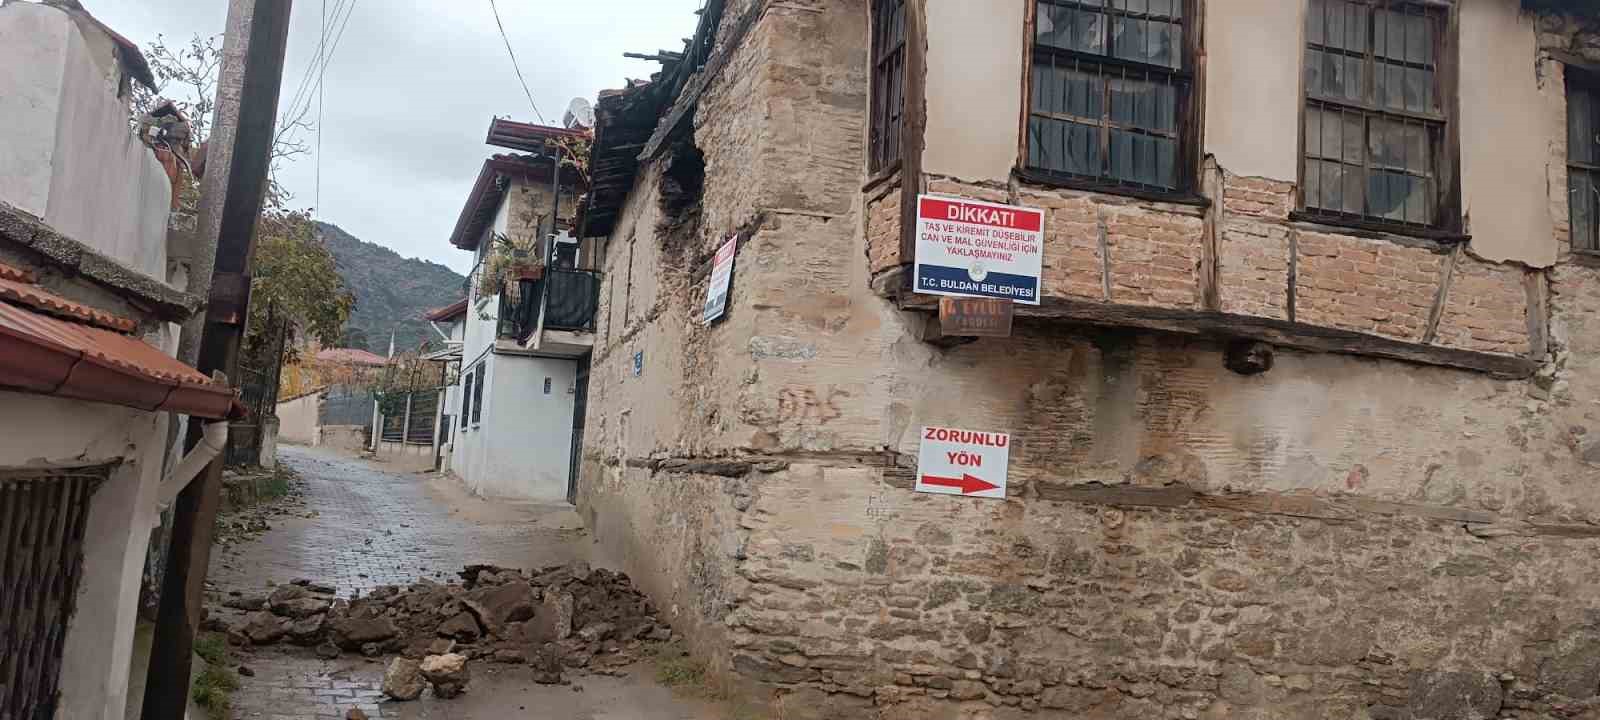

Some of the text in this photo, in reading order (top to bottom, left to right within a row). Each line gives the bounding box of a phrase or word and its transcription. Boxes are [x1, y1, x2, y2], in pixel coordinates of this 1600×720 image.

[947, 203, 1015, 226] DİKKAT!
[943, 225, 954, 234] VE
[957, 225, 990, 237] KİREMİT
[921, 232, 939, 243] CAN
[942, 235, 953, 244] VE
[955, 236, 973, 246] MAL
[1021, 243, 1038, 255] İÇİN
[921, 277, 1034, 297] T.C. BULDAN BELEDİYESİ
[925, 427, 1007, 447] ZORUNLU
[947, 449, 982, 467] YÖN
